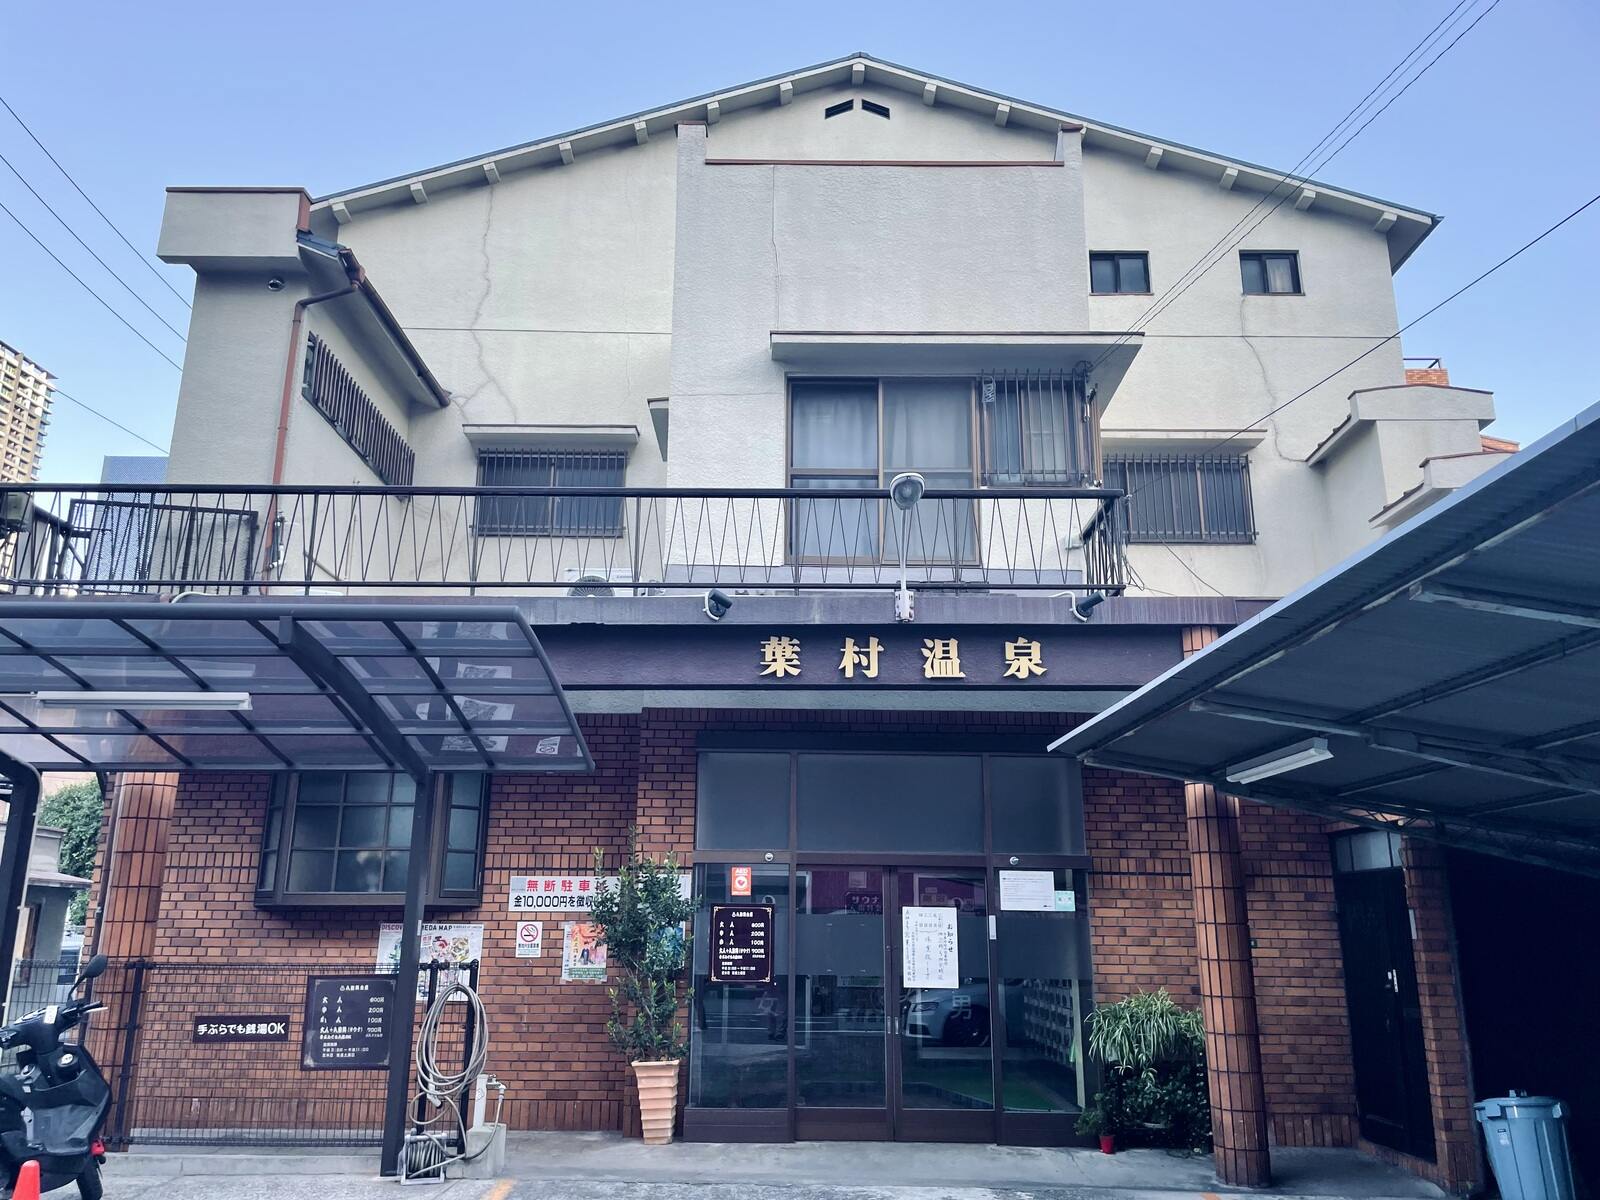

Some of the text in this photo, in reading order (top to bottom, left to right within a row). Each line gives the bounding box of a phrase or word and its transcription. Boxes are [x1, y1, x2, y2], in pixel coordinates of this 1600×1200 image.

[759, 636, 1048, 679] 葉村温泉
[526, 879, 602, 893] 無断駐車
[513, 895, 599, 908] 金10,000円を徴収
[951, 994, 972, 1020] 男
[197, 1022, 286, 1035] 手ぶらでも銭湯OK
